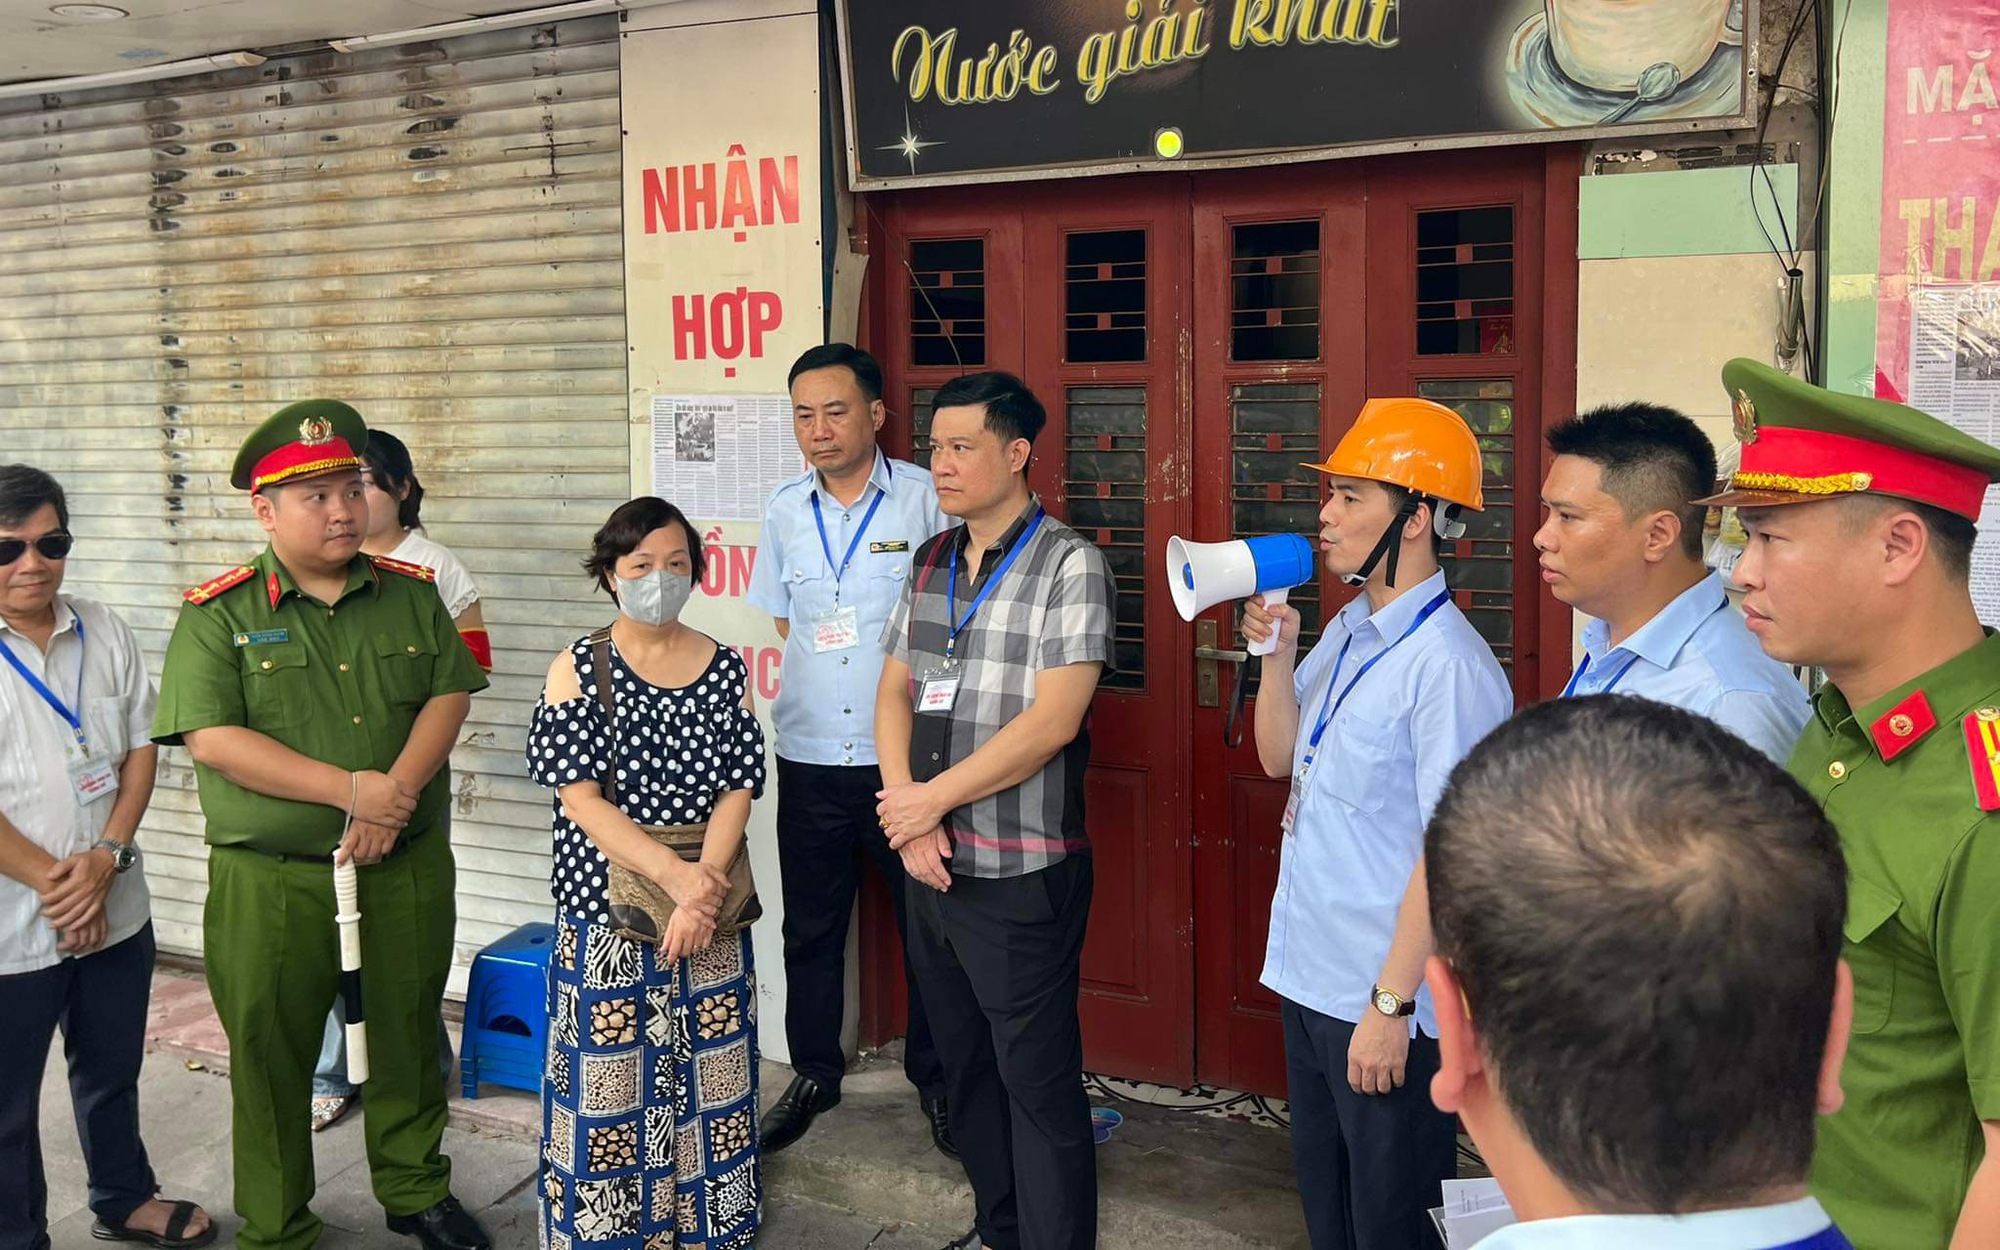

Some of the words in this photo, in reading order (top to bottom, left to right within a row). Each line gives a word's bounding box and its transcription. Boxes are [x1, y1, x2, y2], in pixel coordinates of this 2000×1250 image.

[891, 25, 1061, 106] Nước
[642, 143, 800, 243] NHẬN
[671, 286, 783, 378] HỢP
